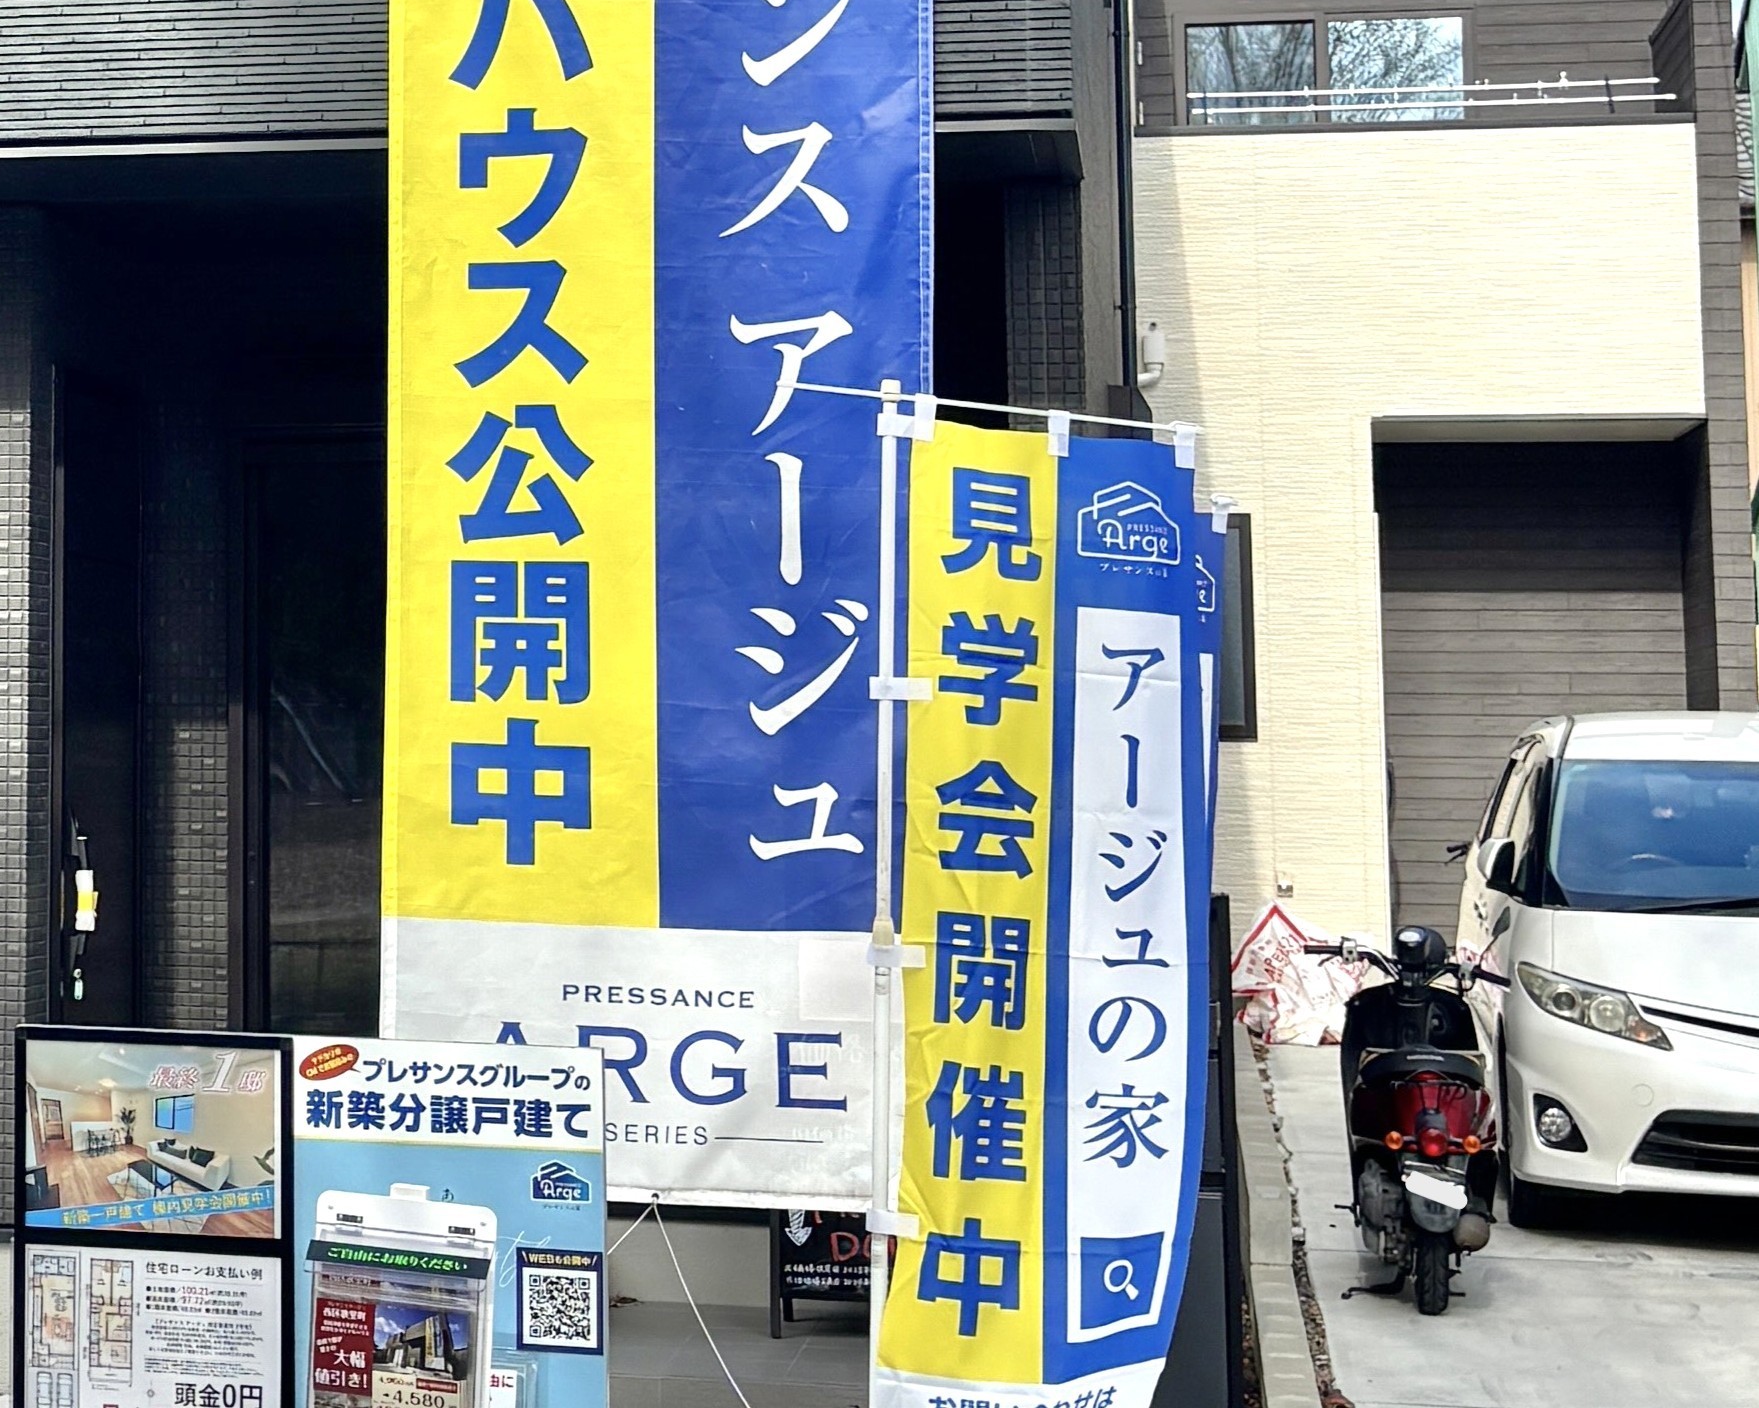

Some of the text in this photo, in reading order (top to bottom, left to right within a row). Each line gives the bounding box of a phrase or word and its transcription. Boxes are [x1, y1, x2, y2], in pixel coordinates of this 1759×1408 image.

[1097, 519, 1168, 559] Arge
[730, 310, 870, 861] アージュ
[917, 467, 1042, 1337] 見学会開催中
[1083, 642, 1170, 1168] アージュの家
[561, 984, 755, 1009] PRESSANCE
[363, 1057, 591, 1091] プレサンスグループの
[495, 1021, 847, 1112] RGE
[306, 1089, 592, 1139] 新築分譲戸建て
[604, 1122, 709, 1146] SERIES
[540, 1179, 582, 1200] Arge
[174, 1382, 263, 1408] 頭金0円
